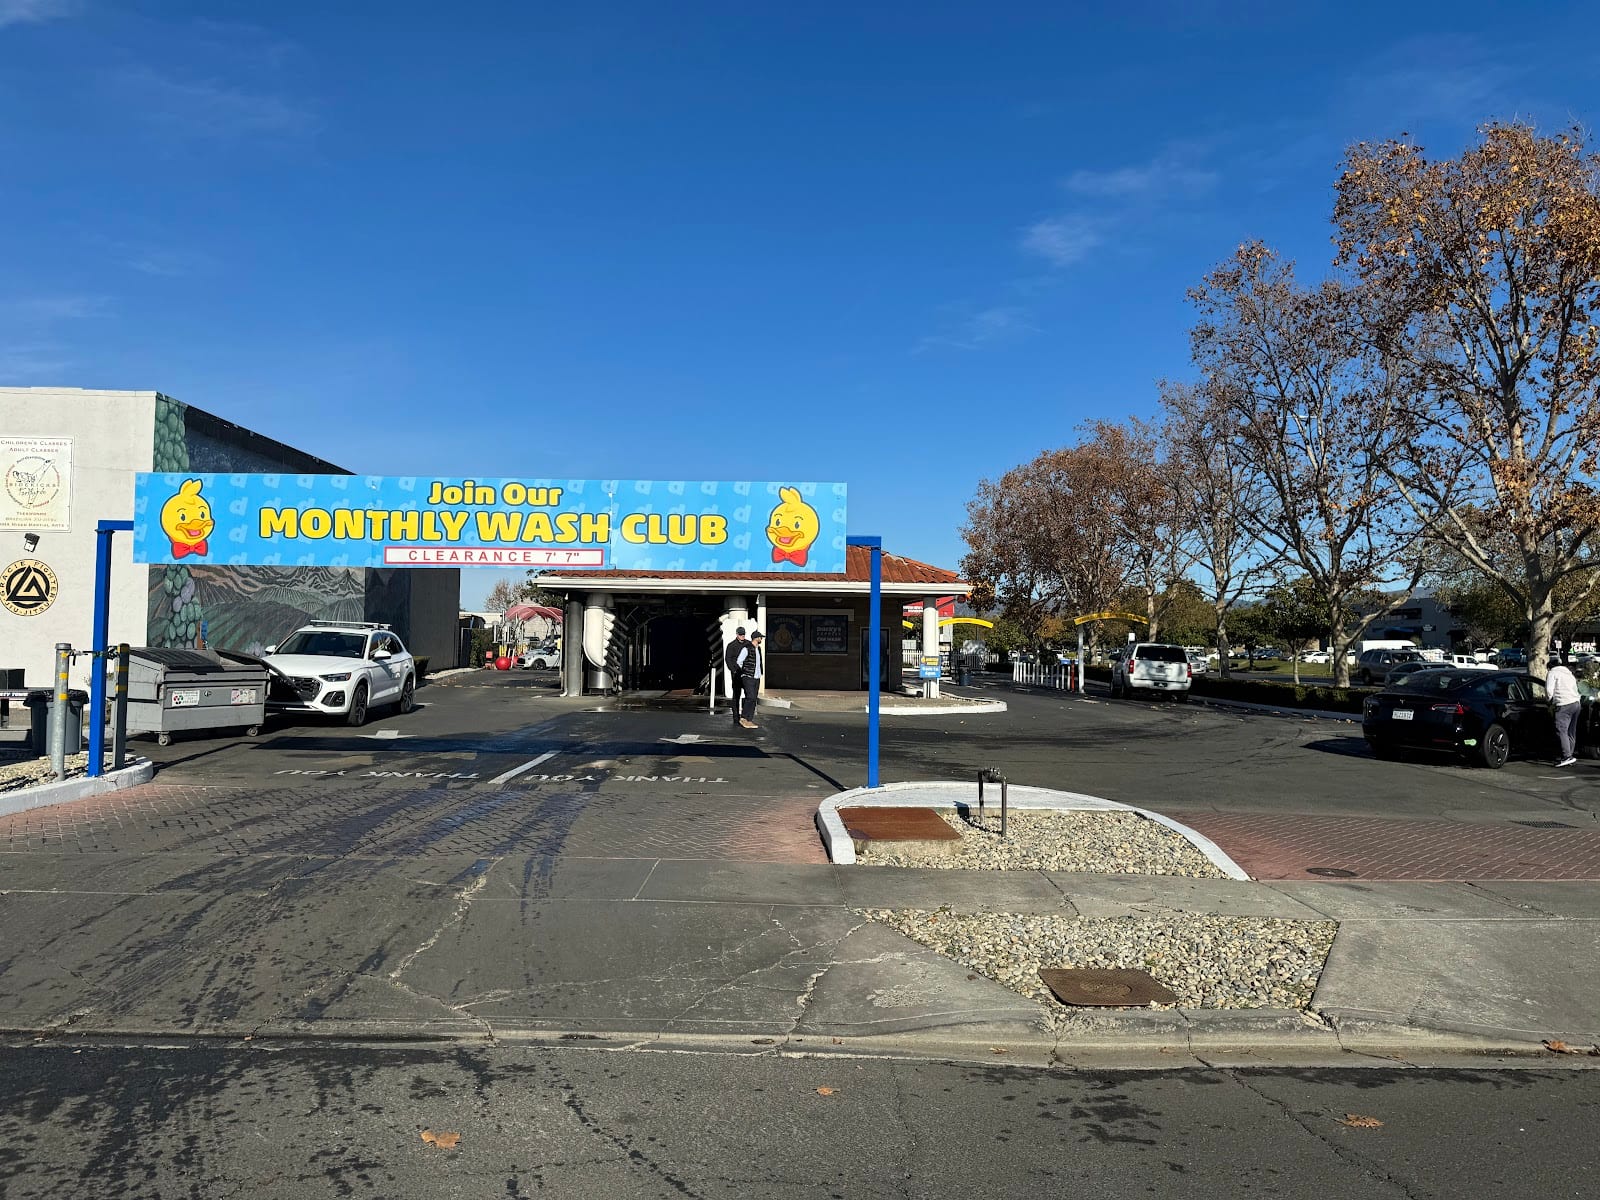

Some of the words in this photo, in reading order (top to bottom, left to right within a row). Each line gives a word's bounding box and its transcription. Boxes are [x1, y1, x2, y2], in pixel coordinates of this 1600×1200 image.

[427, 480, 496, 505] Join
[501, 482, 563, 506] Our
[259, 507, 469, 541] MONTHLY
[475, 510, 610, 543] WASH
[621, 512, 728, 545] CLUB
[408, 550, 532, 563] CLEARANCE
[545, 552, 557, 563] 7'
[565, 552, 580, 564] 7"
[33, 561, 57, 599] FIGHTER
[612, 774, 729, 783] THANK
